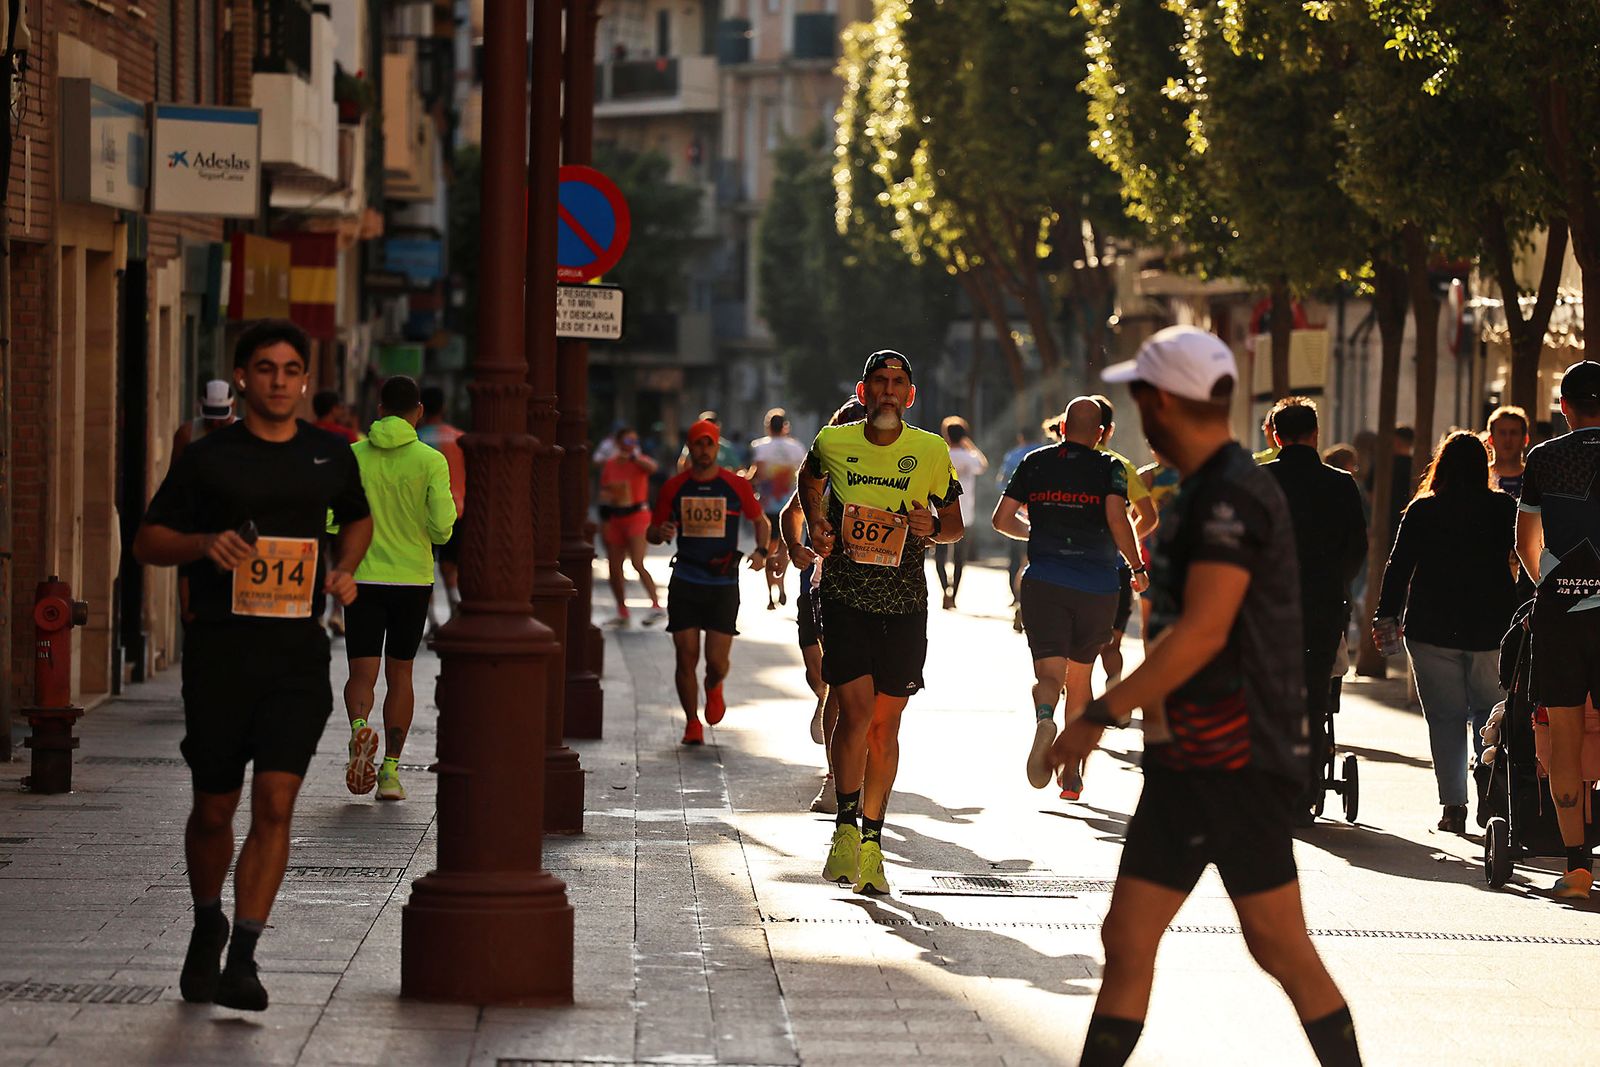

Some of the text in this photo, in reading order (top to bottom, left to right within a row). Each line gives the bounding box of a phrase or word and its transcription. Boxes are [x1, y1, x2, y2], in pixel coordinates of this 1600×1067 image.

[192, 151, 250, 169] Adeslas
[564, 289, 613, 300] RESIDENTES
[562, 310, 568, 319] Y
[569, 310, 614, 321] DESCARGA
[573, 322, 585, 332] DE
[593, 324, 599, 332] A
[686, 508, 722, 522] 1039
[851, 520, 895, 544] 867
[251, 559, 304, 587] 914
